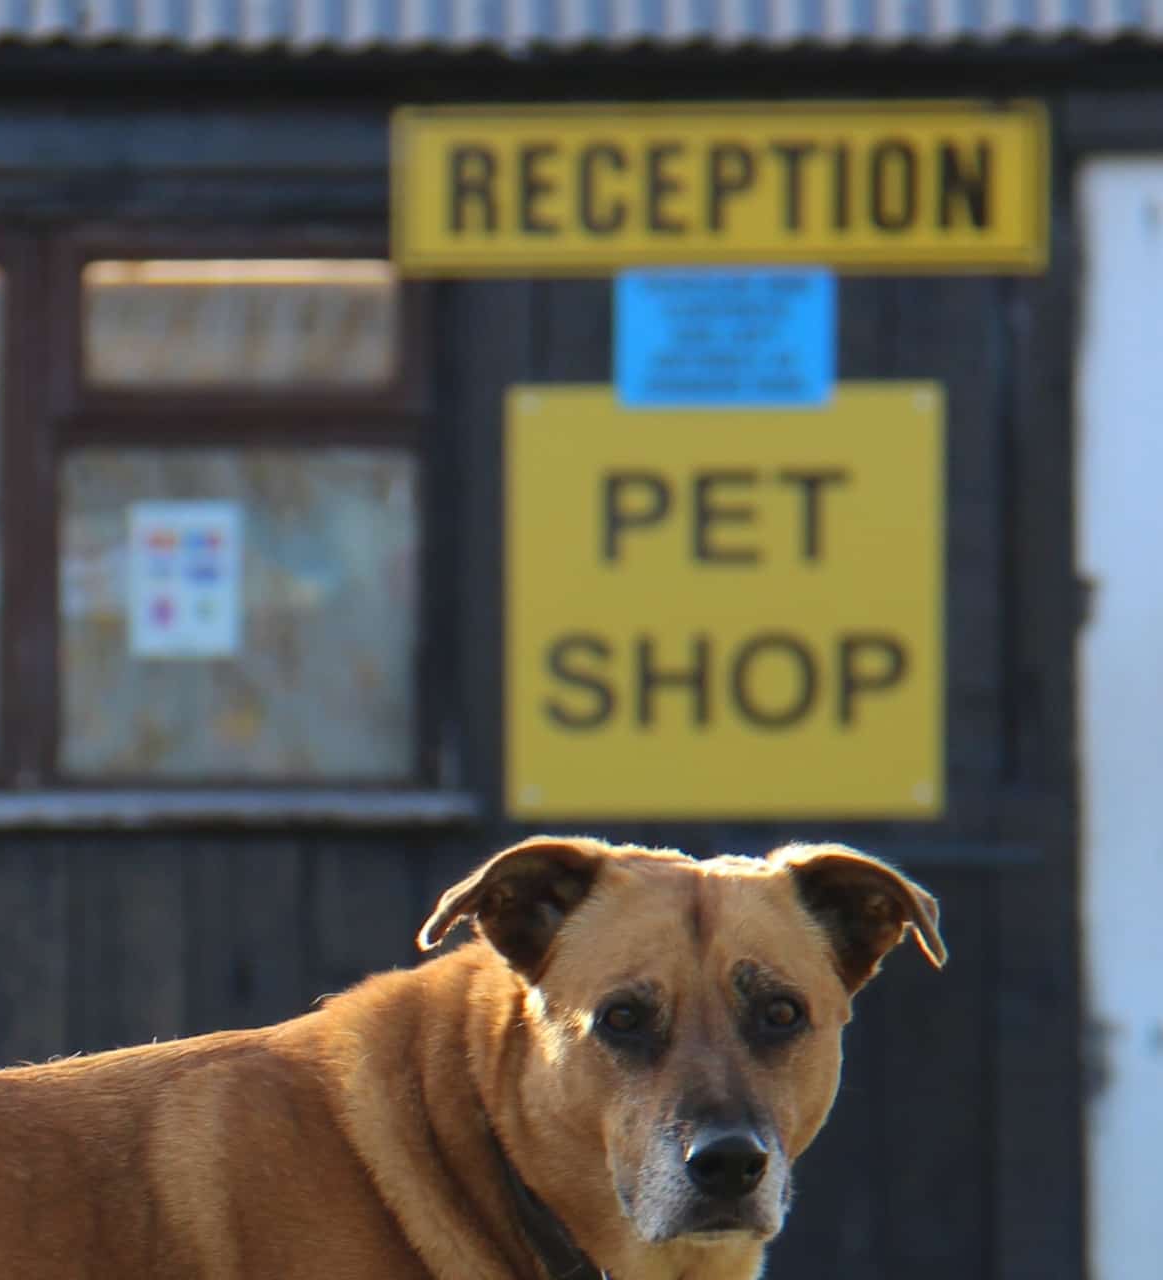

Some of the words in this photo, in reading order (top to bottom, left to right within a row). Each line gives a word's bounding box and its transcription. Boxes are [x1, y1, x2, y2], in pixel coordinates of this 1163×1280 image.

[447, 136, 994, 236] RECEPTION
[601, 468, 852, 566] PET
[544, 631, 912, 734] SHOP
